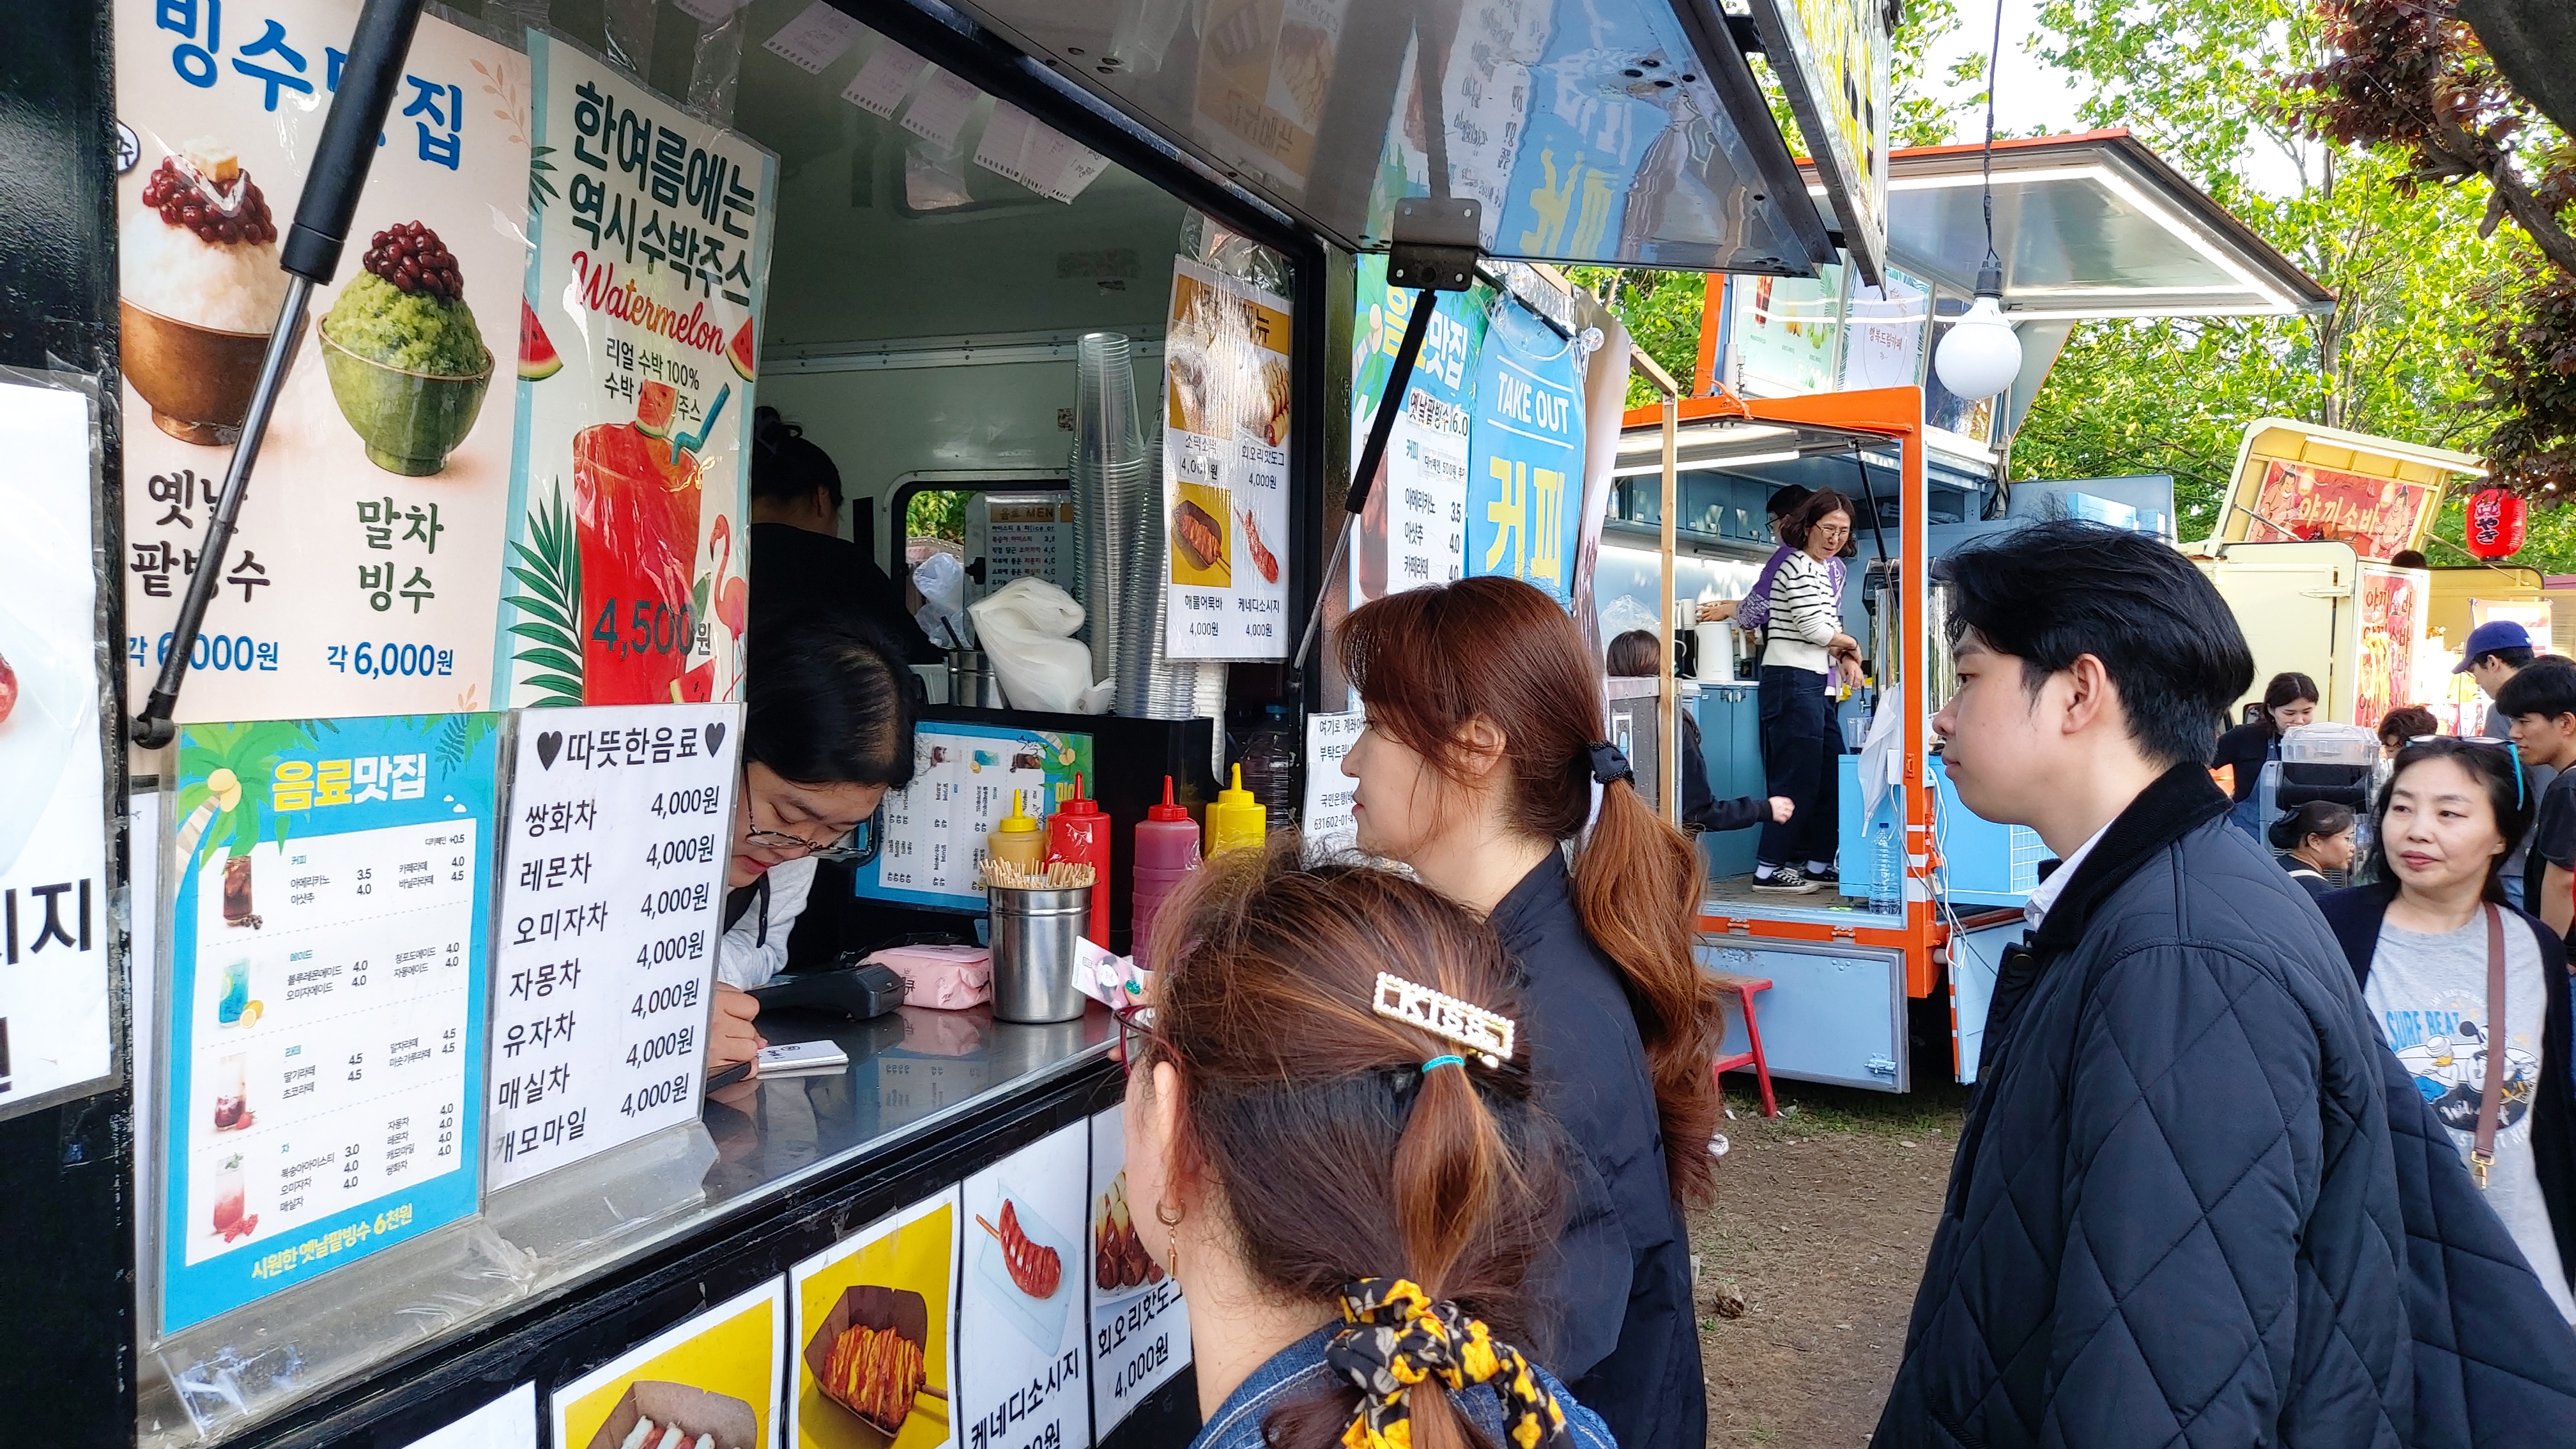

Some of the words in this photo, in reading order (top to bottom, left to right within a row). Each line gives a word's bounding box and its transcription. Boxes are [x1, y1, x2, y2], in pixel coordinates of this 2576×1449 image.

[155, 0, 464, 171] 빙수집
[574, 80, 755, 240] 한여름에는
[570, 172, 752, 307] 역시수박주스
[572, 250, 726, 356] Watermelon
[1383, 286, 1468, 391] 음맛집
[1869, 326, 1903, 351] 행복드림카페
[607, 337, 634, 372] 리얼
[638, 349, 663, 381] 수박
[667, 360, 700, 390] 100%
[604, 372, 634, 404] 수박
[1497, 371, 1531, 429] TAKE
[1535, 389, 1570, 434] OUT
[1452, 413, 1468, 437] 6.0
[1242, 445, 1284, 466] 회오리핫도그
[1406, 439, 1418, 461] 커피
[1248, 473, 1276, 489] 4,000원
[1406, 487, 1436, 515] 아메리카노
[1450, 502, 1461, 523] 3.5
[1486, 456, 1567, 587] 커피
[2299, 493, 2380, 538] 야끼소바
[356, 496, 445, 555] 말차
[1405, 521, 1423, 546] 아샷추
[1449, 533, 1460, 554] 4.0
[358, 562, 435, 614] 빙수
[1448, 564, 1459, 583] 4.0
[1185, 595, 1223, 611] 해물어묵바
[1238, 598, 1280, 613] 케네디소시지
[592, 597, 711, 661] 4,500원
[1190, 622, 1218, 637] 4,000원
[1246, 624, 1272, 637] 4,000원
[129, 636, 148, 667] 각
[157, 632, 278, 671] 6000원
[328, 645, 348, 673] 각
[355, 641, 453, 679] 6,000원
[1319, 719, 1340, 735] 여기로
[567, 726, 698, 770] 따뜻한음료
[272, 753, 427, 813] 음료맛집
[525, 799, 597, 837] 쌍화차
[651, 785, 720, 820] 4,000원
[1314, 813, 1356, 830] 631602-01-4
[449, 834, 464, 844] +0.5
[291, 855, 307, 865] 커피
[451, 871, 464, 881] 4.5
[452, 856, 464, 866] 4.0
[521, 852, 592, 891] 레몬차
[646, 834, 715, 870] 4,000원
[291, 874, 330, 889] 아메리카노
[357, 868, 372, 880] 3.5
[291, 893, 315, 905] 아샷추
[356, 884, 372, 895] 4.0
[513, 901, 608, 946] 오미자차
[641, 882, 710, 919] 4,000원
[394, 963, 429, 977] 자몽에이드
[445, 956, 459, 967] 4.0
[395, 946, 436, 964] 청포도에이드
[447, 942, 459, 953] 4.0
[509, 958, 581, 1002] 자몽차
[636, 930, 705, 968] 4,000원
[286, 982, 334, 1001] 오미자에이드
[351, 975, 367, 987] 4.0
[288, 965, 343, 985] 블루레몬에이드
[353, 960, 368, 972] 4.0
[443, 1028, 456, 1039] 4.5
[503, 1010, 576, 1058] 유자차
[631, 977, 700, 1019] 4,000원
[2386, 1011, 2421, 1053] SURF
[2425, 1011, 2459, 1035] BEAT
[442, 1043, 455, 1054] 4.5
[284, 1065, 316, 1083] 딸기라떼
[349, 1053, 363, 1065] 4.5
[499, 1062, 571, 1109] 매실차
[625, 1025, 694, 1067] 4,000원
[282, 1082, 314, 1099] 초코라떼
[348, 1069, 362, 1081] 4.5
[620, 1073, 689, 1117] 4,000원
[440, 1103, 453, 1115] 4.0
[387, 1131, 409, 1145] 레몬차
[439, 1117, 452, 1129] 4.0
[438, 1131, 452, 1144] 4.0
[280, 1153, 335, 1179] 복숭아아이스티
[345, 1144, 360, 1157] 3.0
[438, 1144, 451, 1157] 4.0
[280, 1176, 312, 1195] 오미자차
[344, 1160, 358, 1173] 4.0
[280, 1195, 304, 1211] 매실차
[343, 1176, 358, 1189] 4.0
[251, 1246, 298, 1279] 시원한
[299, 1221, 371, 1264] 옛날팥빙수
[374, 1202, 413, 1234] 6천원
[1115, 1332, 1168, 1398] 4,000원
[972, 1347, 1078, 1449] 케네디소시지
